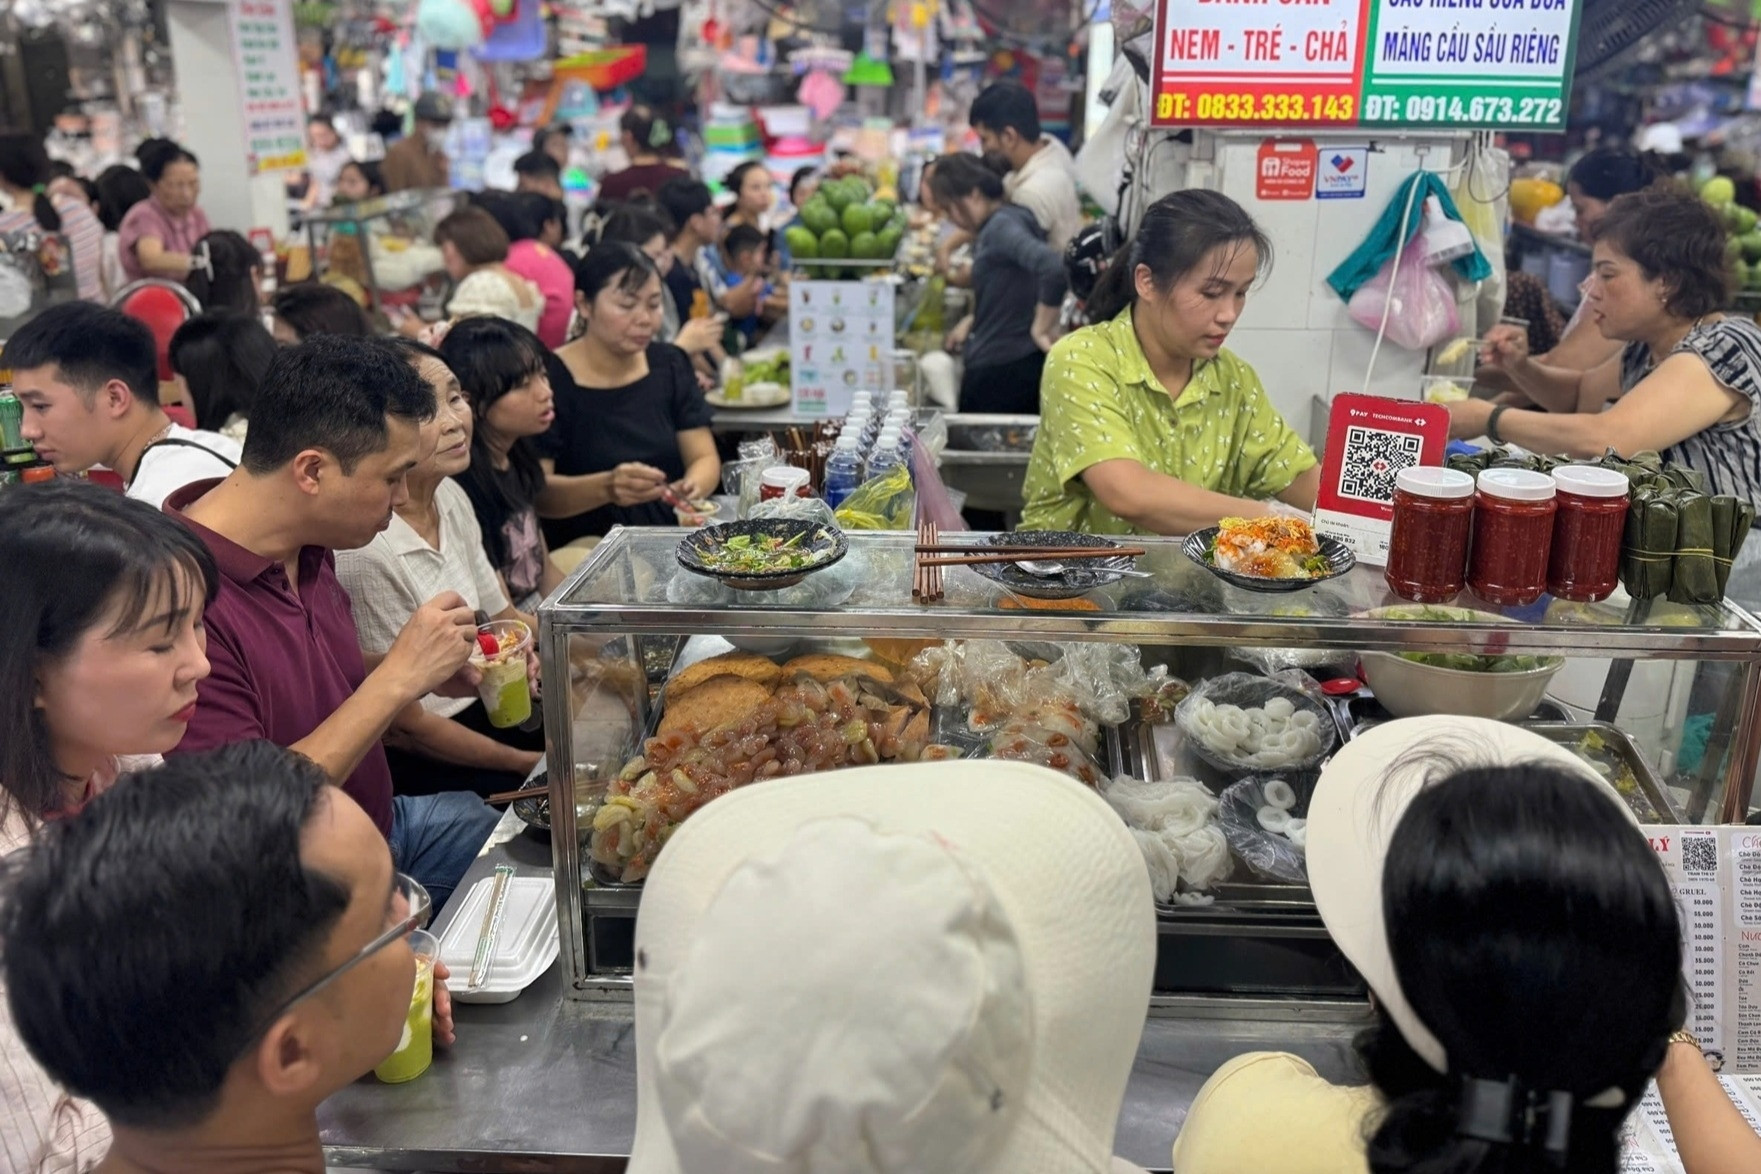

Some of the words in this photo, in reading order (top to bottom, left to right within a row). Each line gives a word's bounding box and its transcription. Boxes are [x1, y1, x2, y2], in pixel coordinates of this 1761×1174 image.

[1170, 29, 1220, 60] NEM
[1244, 23, 1282, 61] TRÉ
[1305, 20, 1347, 61] CHẢ
[1383, 26, 1432, 62] MÃNG
[1436, 21, 1470, 62] CẦU
[1473, 22, 1508, 63] SẦU
[1510, 27, 1560, 64] RIÊNG
[1157, 93, 1191, 119] ĐT:
[1197, 93, 1354, 120] 0833.333.143
[1365, 94, 1400, 121] ĐT:
[1405, 95, 1563, 123] 0914.673.272
[1281, 165, 1310, 177] Food
[1372, 413, 1413, 424] TECHCOMBANK
